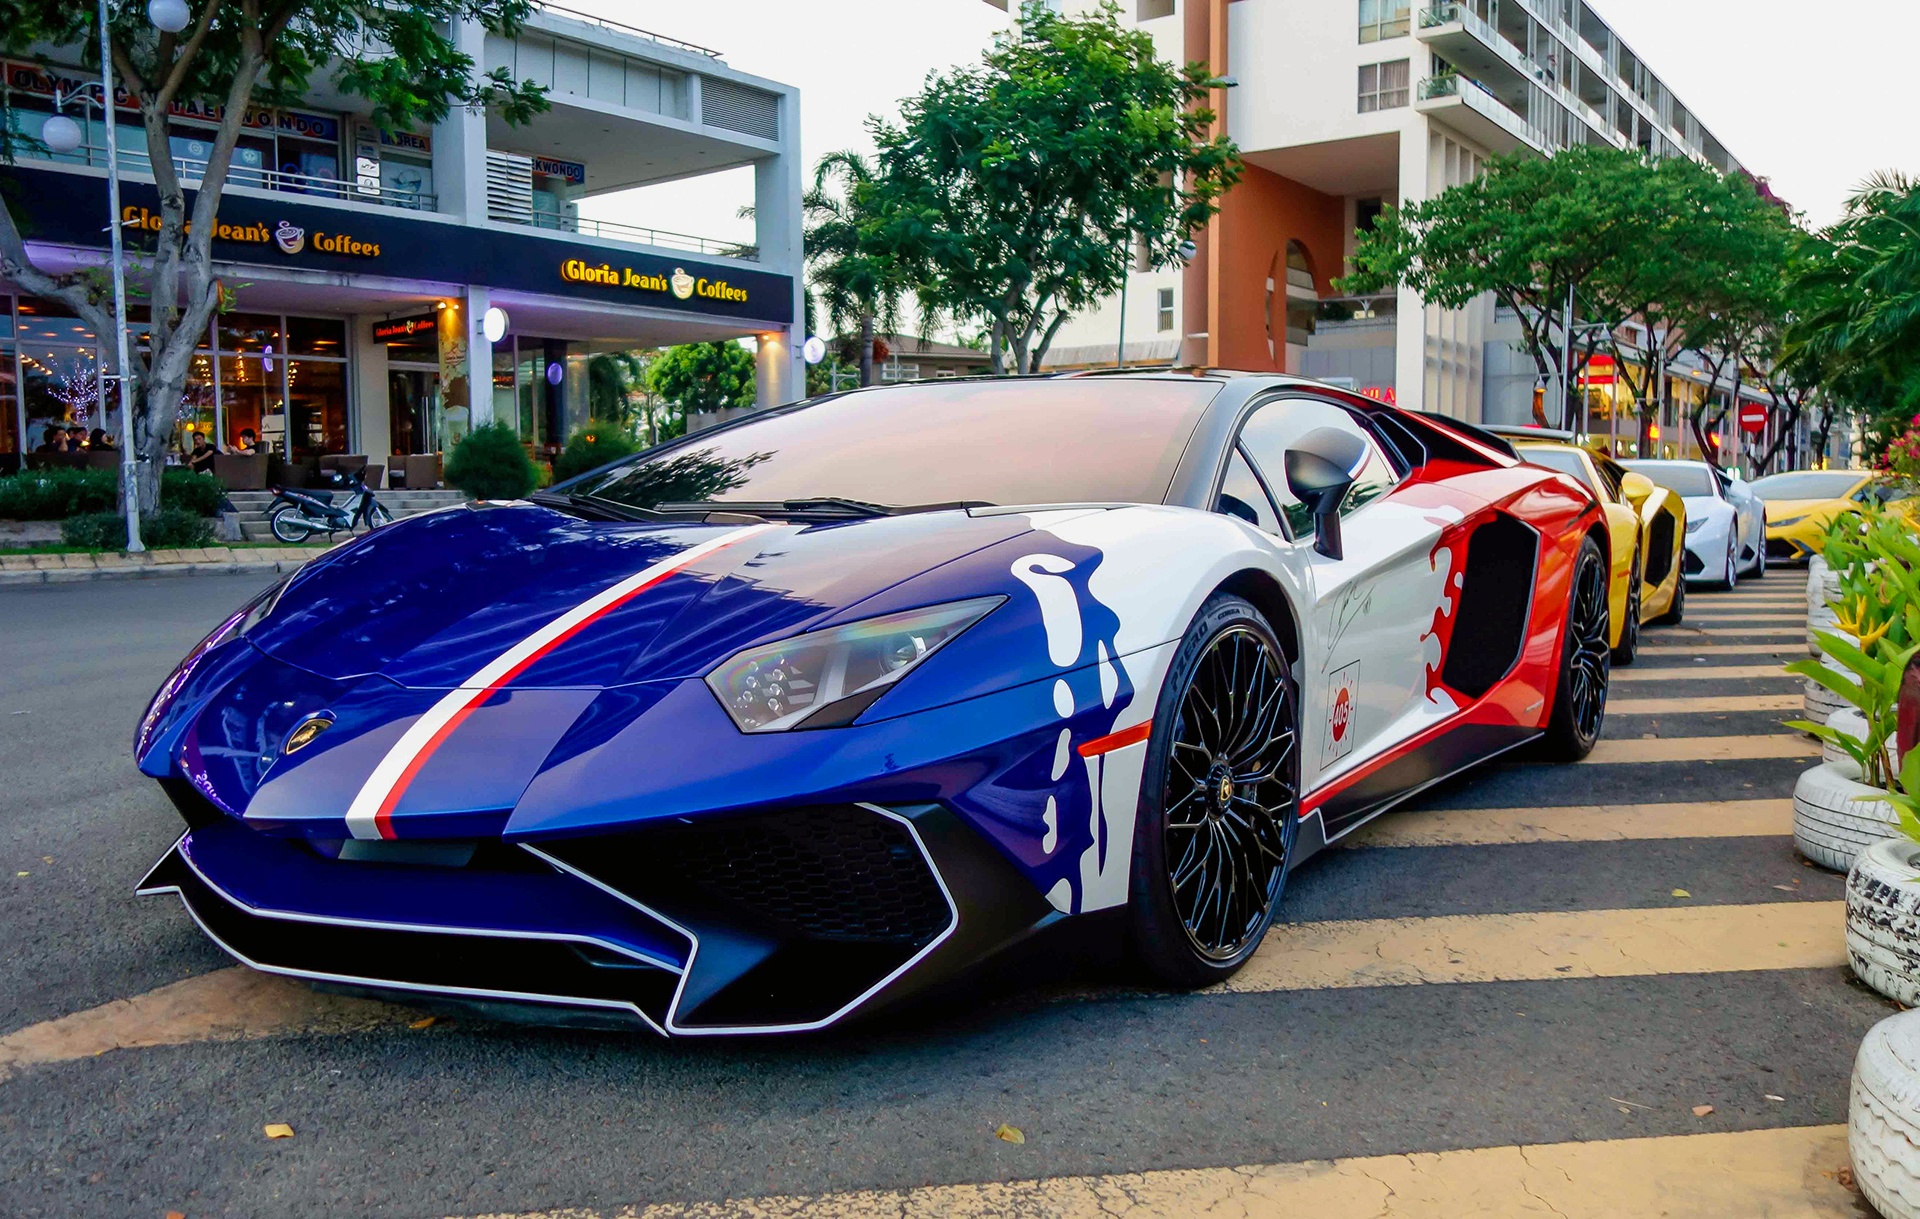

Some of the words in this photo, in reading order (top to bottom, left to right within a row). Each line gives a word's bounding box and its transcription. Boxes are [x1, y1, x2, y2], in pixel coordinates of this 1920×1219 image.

[14, 70, 130, 104] OLYMPC
[170, 101, 325, 136] TAEONDO
[122, 206, 191, 235] Gloa
[209, 217, 270, 243] Jean's
[313, 232, 381, 257] Coffees
[564, 259, 620, 285] Gloria
[622, 268, 669, 292] Jean's
[697, 278, 748, 302] Coffees
[1333, 700, 1349, 728] 405
